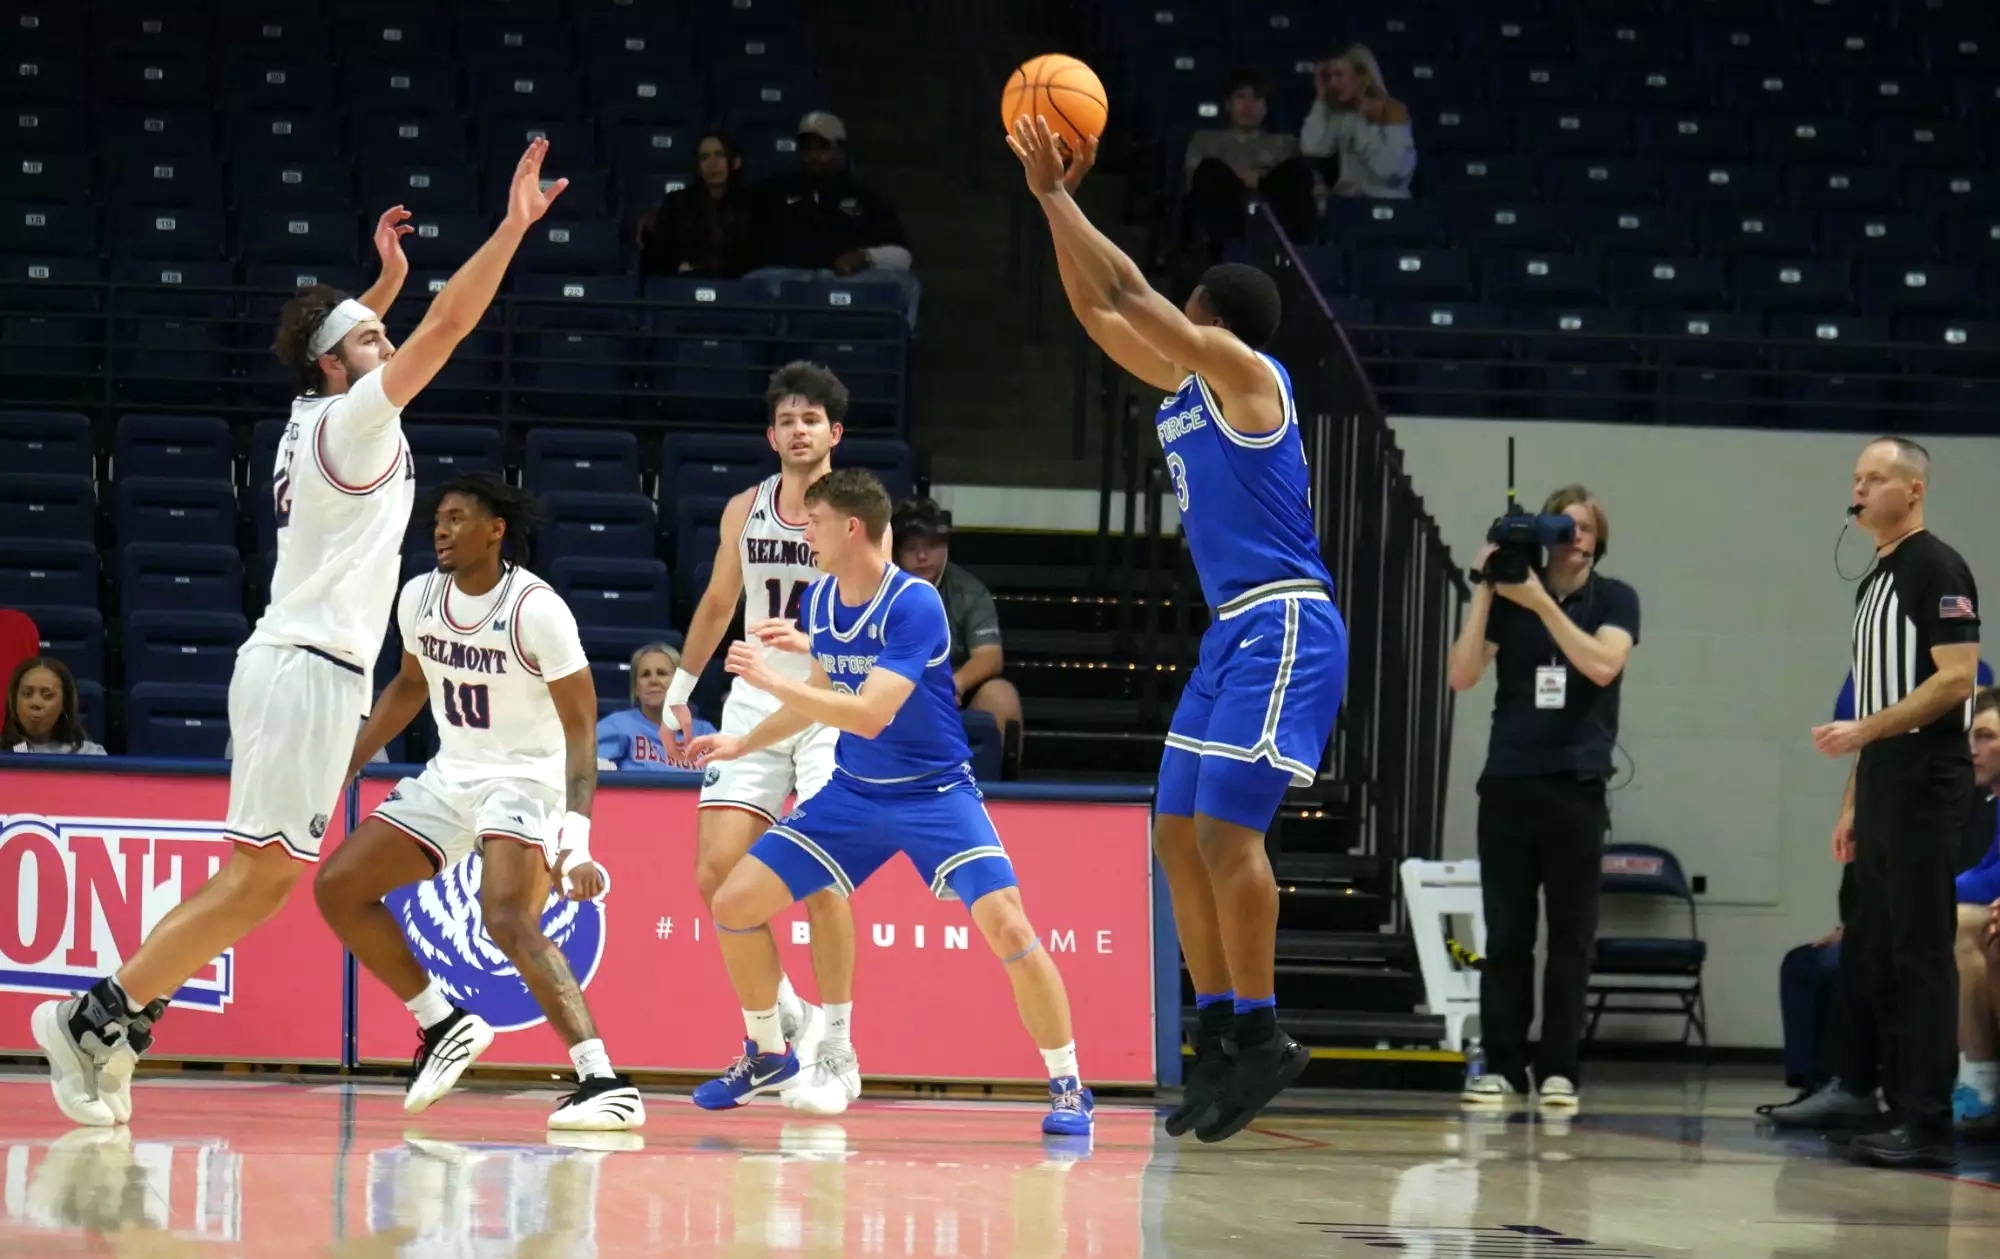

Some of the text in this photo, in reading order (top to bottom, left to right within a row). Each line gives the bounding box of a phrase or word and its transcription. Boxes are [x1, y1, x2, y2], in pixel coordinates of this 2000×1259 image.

[1157, 404, 1207, 449] FORCE
[1166, 451, 1190, 512] 3
[417, 634, 508, 675] BELMONT
[442, 676, 490, 729] 10
